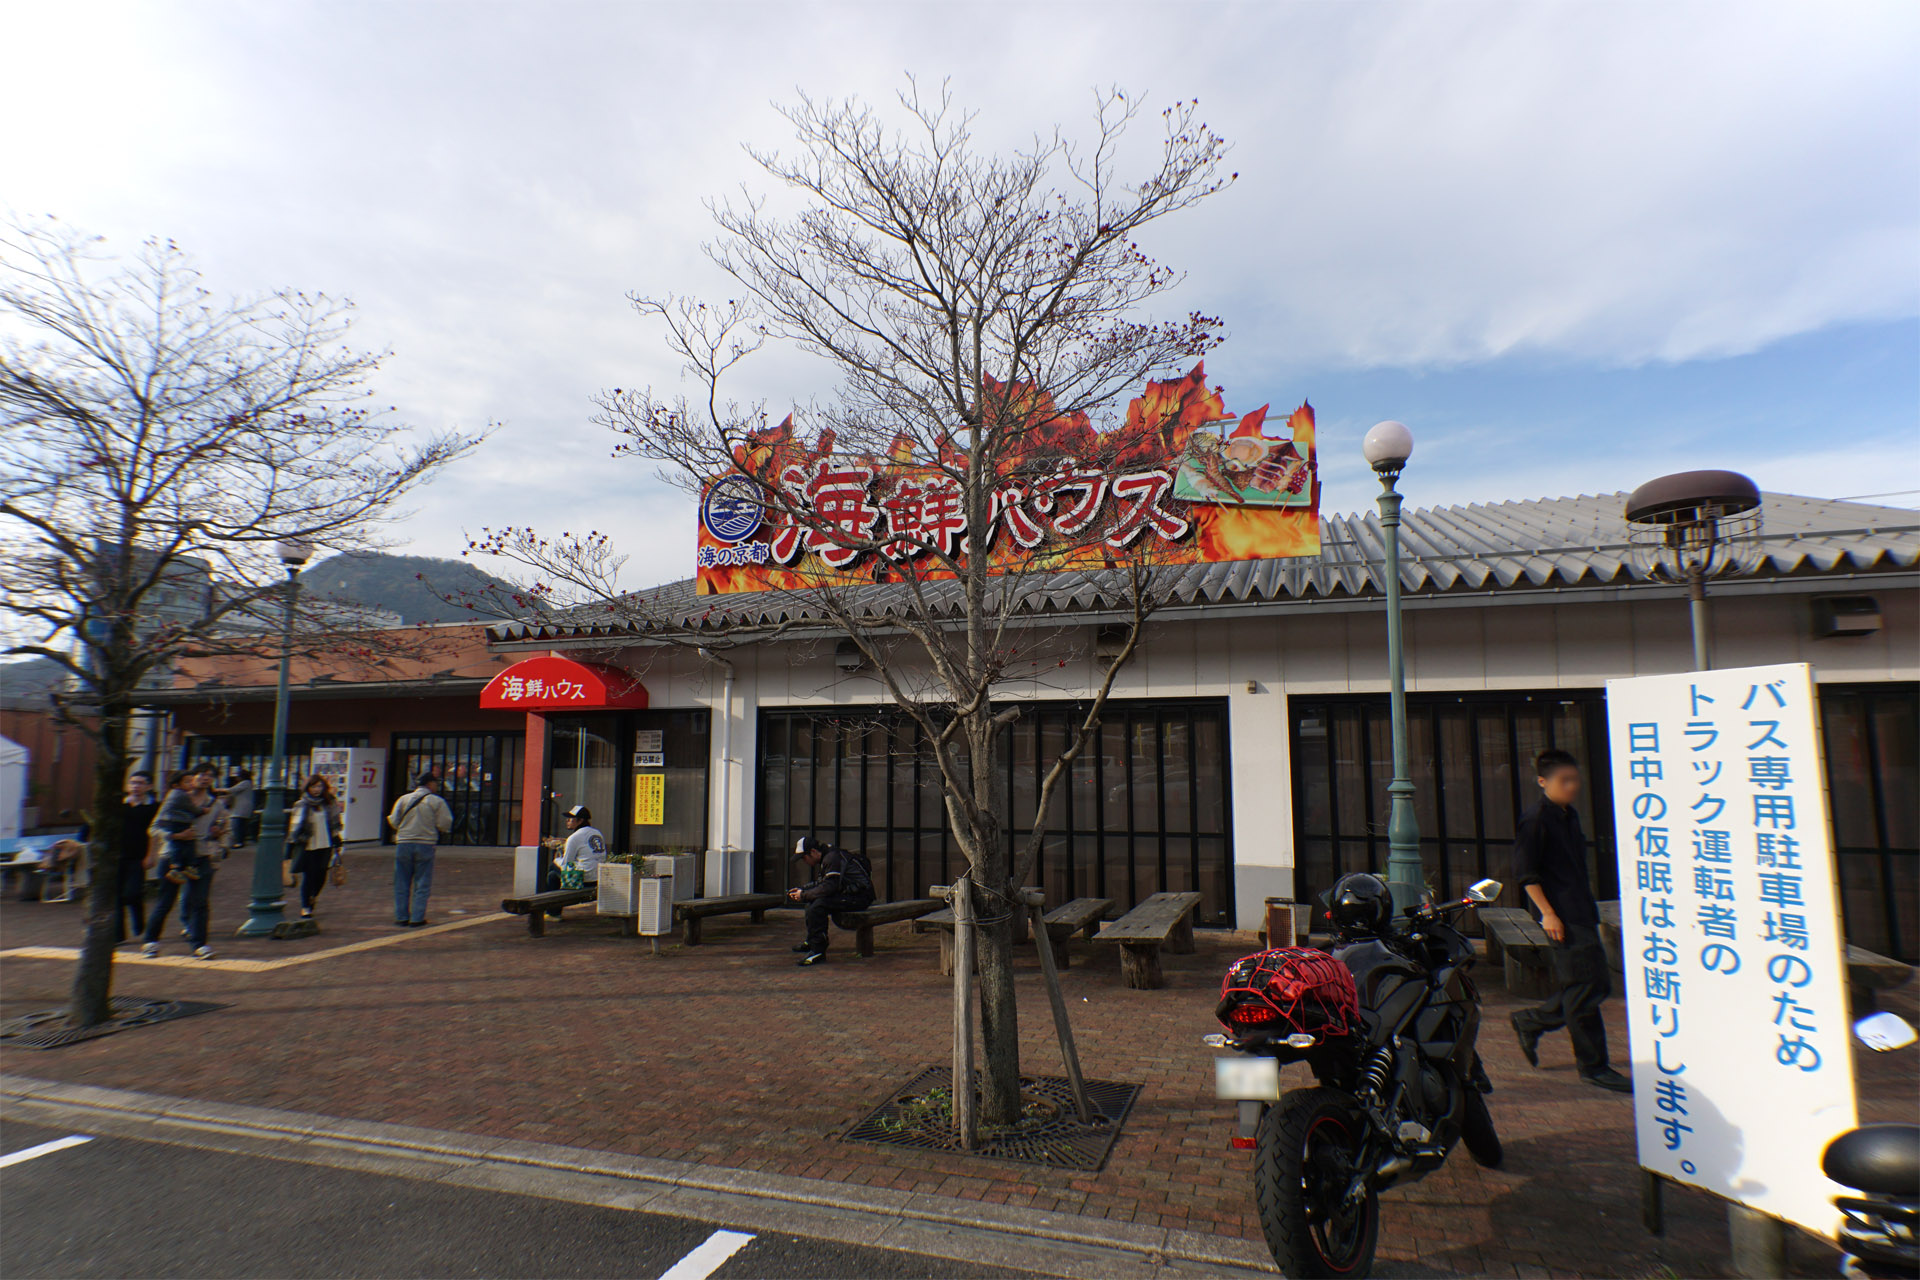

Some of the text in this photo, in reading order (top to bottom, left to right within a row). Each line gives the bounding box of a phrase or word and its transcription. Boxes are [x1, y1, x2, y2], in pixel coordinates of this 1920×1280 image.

[698, 540, 769, 568] 海の京都
[771, 456, 1190, 567] 海鮮ハウス
[501, 675, 585, 701] 海鮮ハウス
[1683, 684, 1741, 975] トラック運転者の
[1740, 679, 1822, 1072] バス専用駐車場のため
[1628, 722, 1697, 1175] 日中の仮眠はお断りします。
